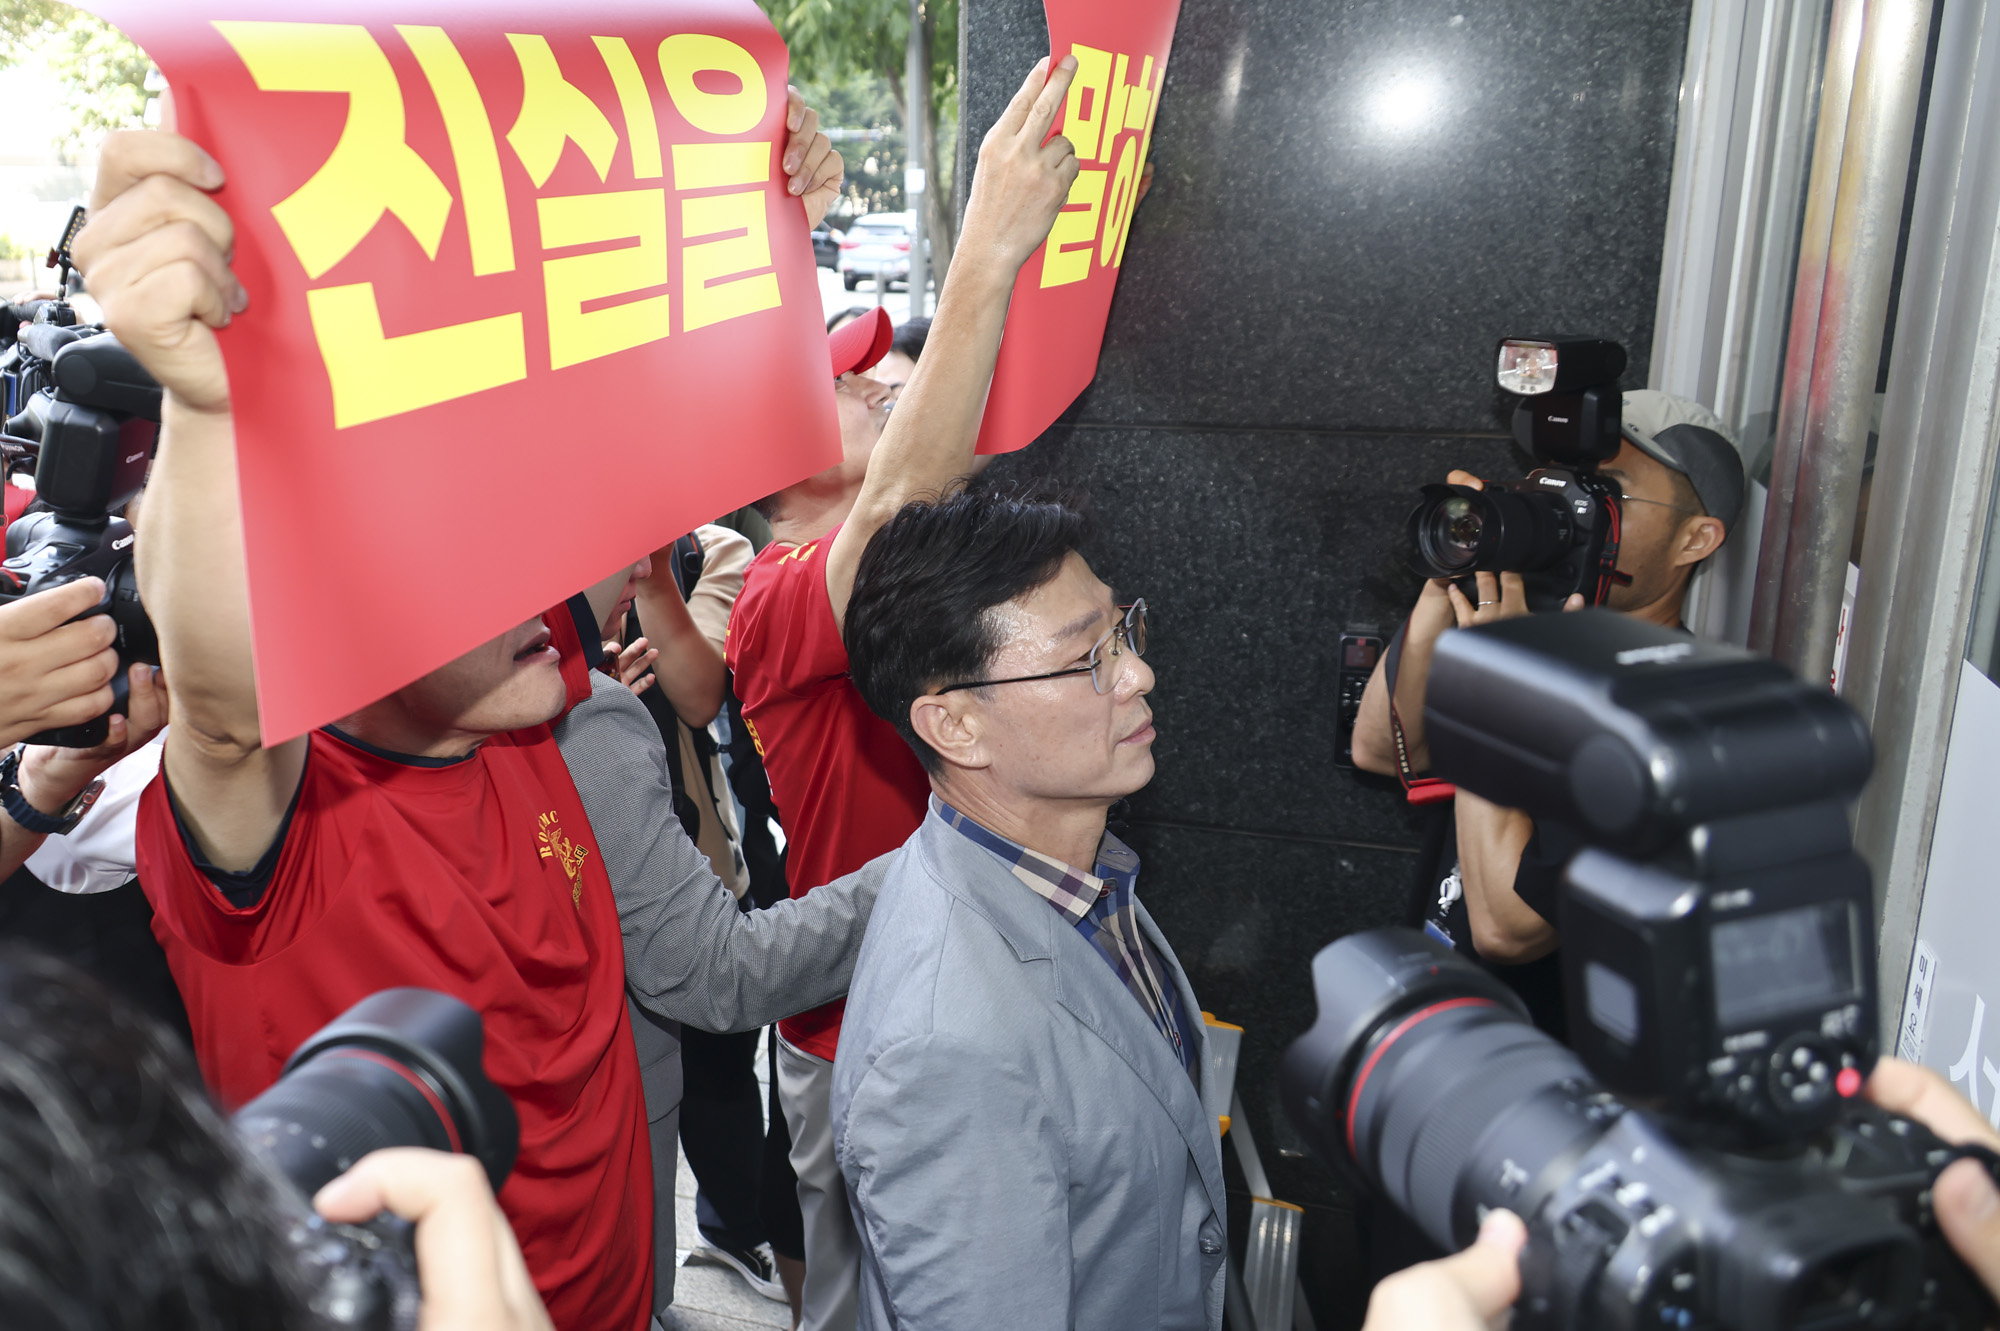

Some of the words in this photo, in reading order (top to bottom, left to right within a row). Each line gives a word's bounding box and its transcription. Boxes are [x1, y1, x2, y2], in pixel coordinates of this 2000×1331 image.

[209, 20, 783, 431] 진실을
[1548, 415, 1569, 423] Canon
[126, 451, 144, 463] Canon
[1539, 477, 1567, 487] Canon
